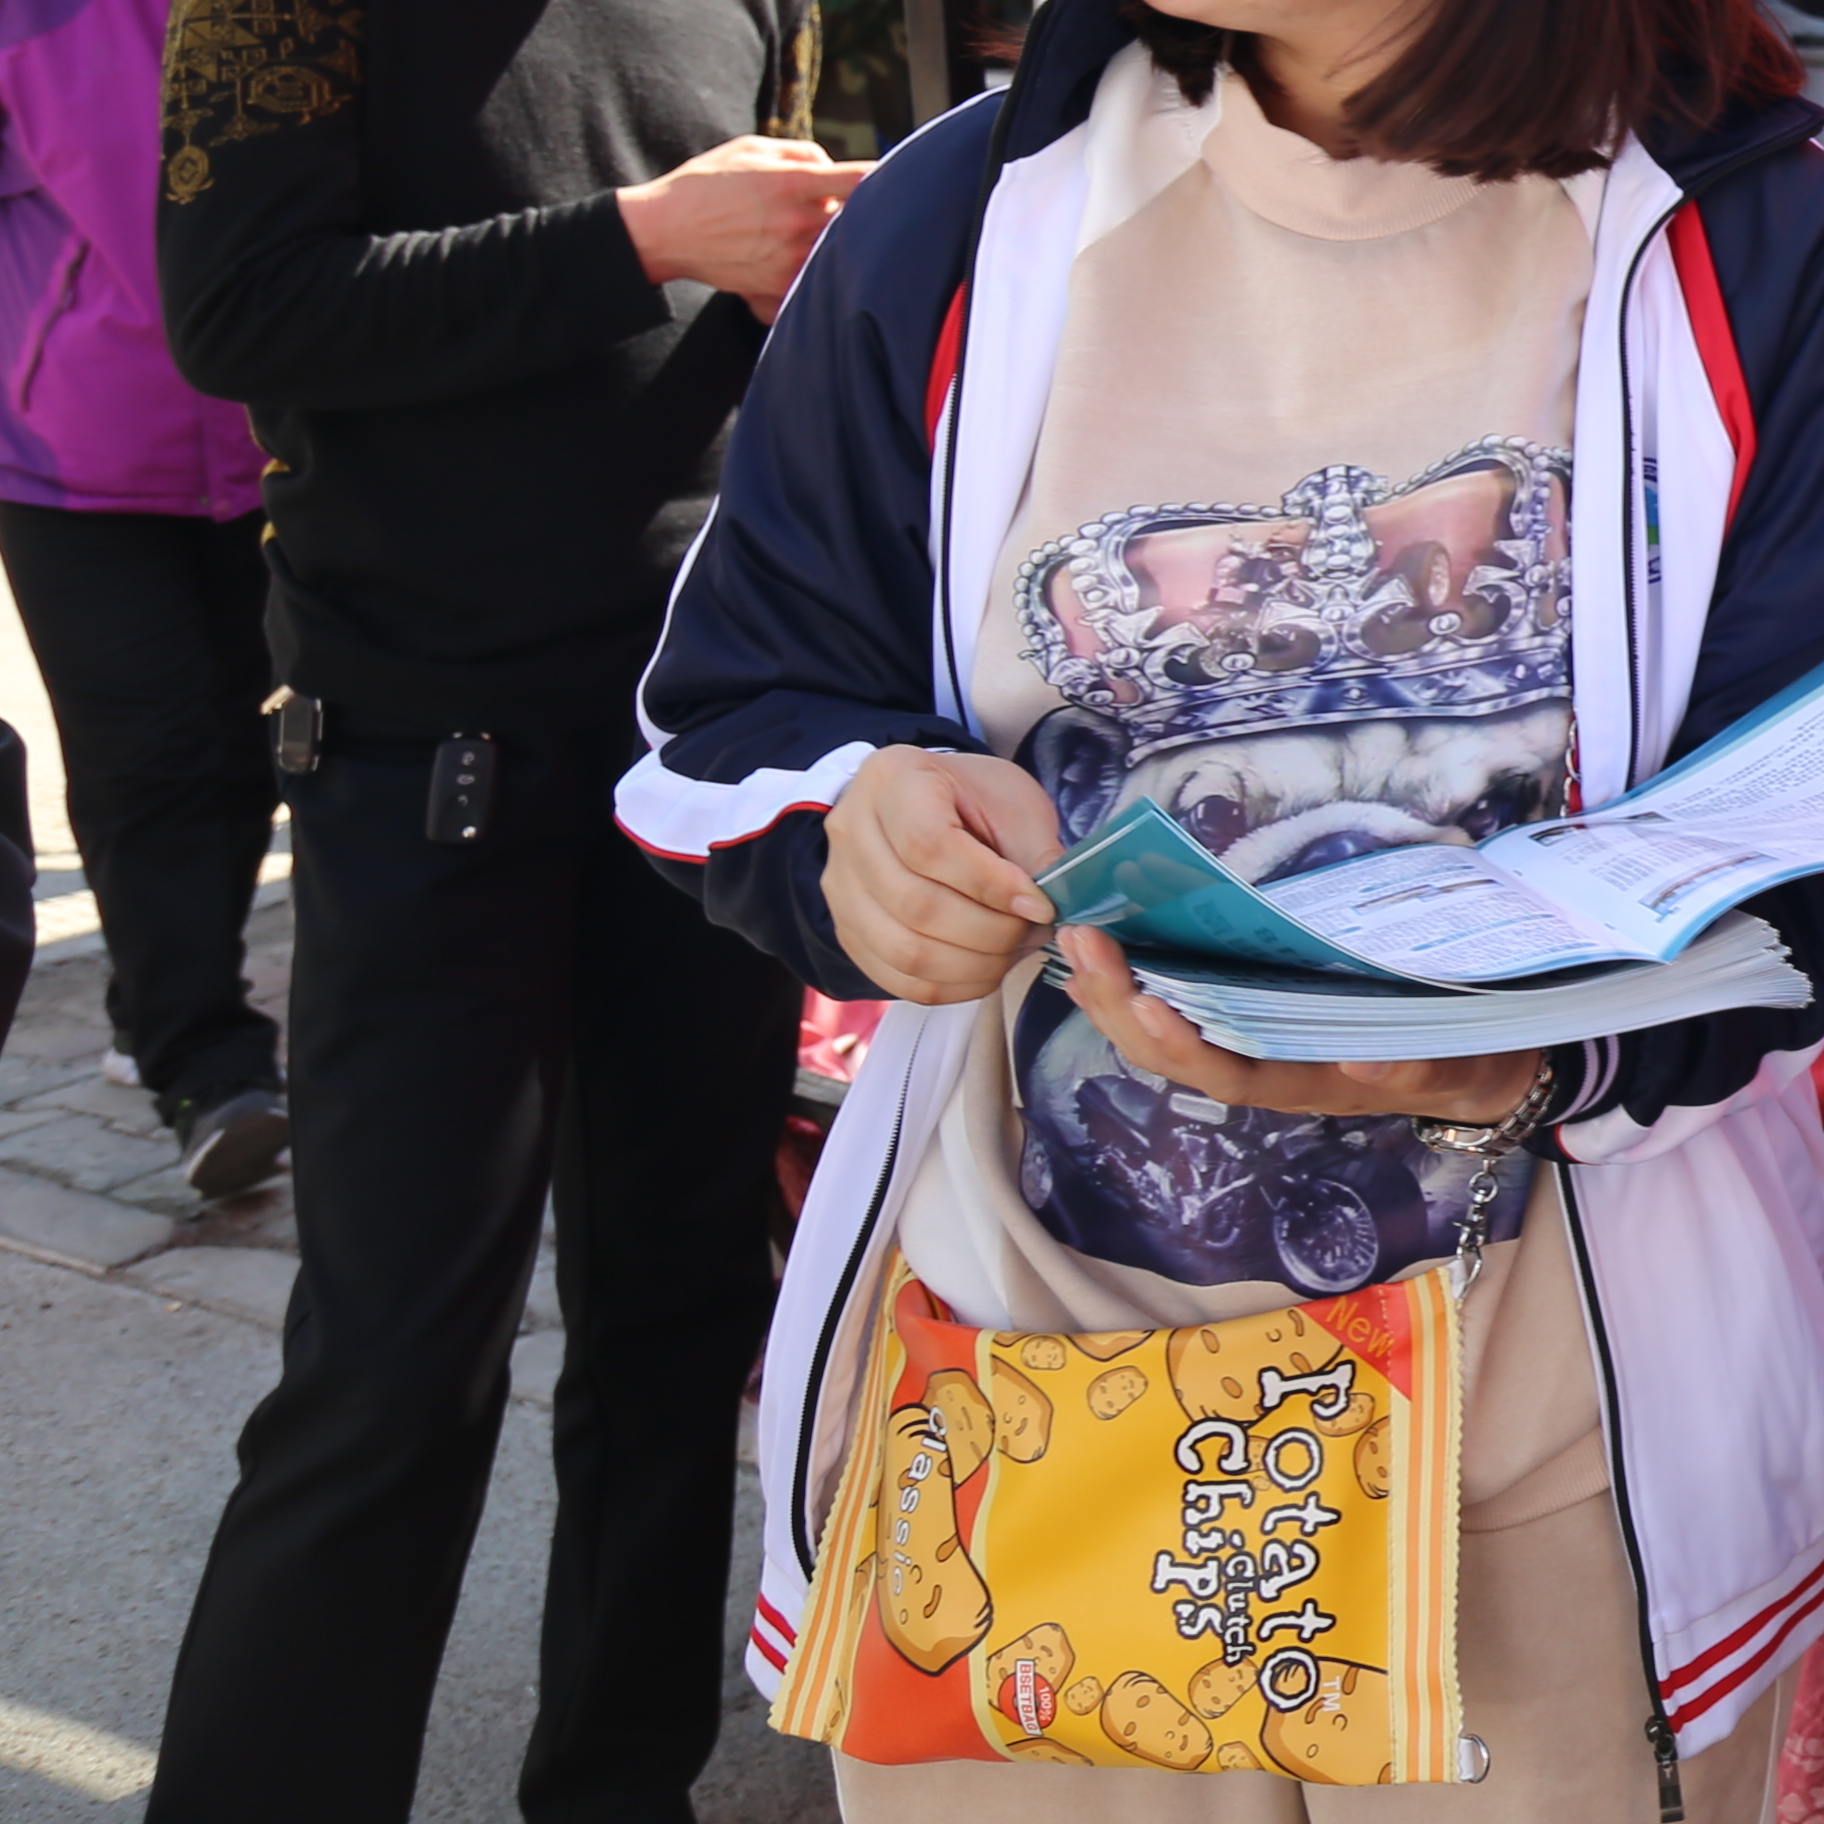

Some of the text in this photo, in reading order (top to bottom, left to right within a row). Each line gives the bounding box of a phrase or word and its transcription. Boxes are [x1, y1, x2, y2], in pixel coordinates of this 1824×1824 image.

[1325, 1295, 1396, 1360] New
[892, 1406, 949, 1596] Classic
[1151, 1417, 1253, 1640] Chips
[1257, 1359, 1356, 1713] Potato
[1223, 1549, 1255, 1667] Clutch
[1035, 1685, 1053, 1723] 100%
[1323, 1676, 1343, 1714] TM
